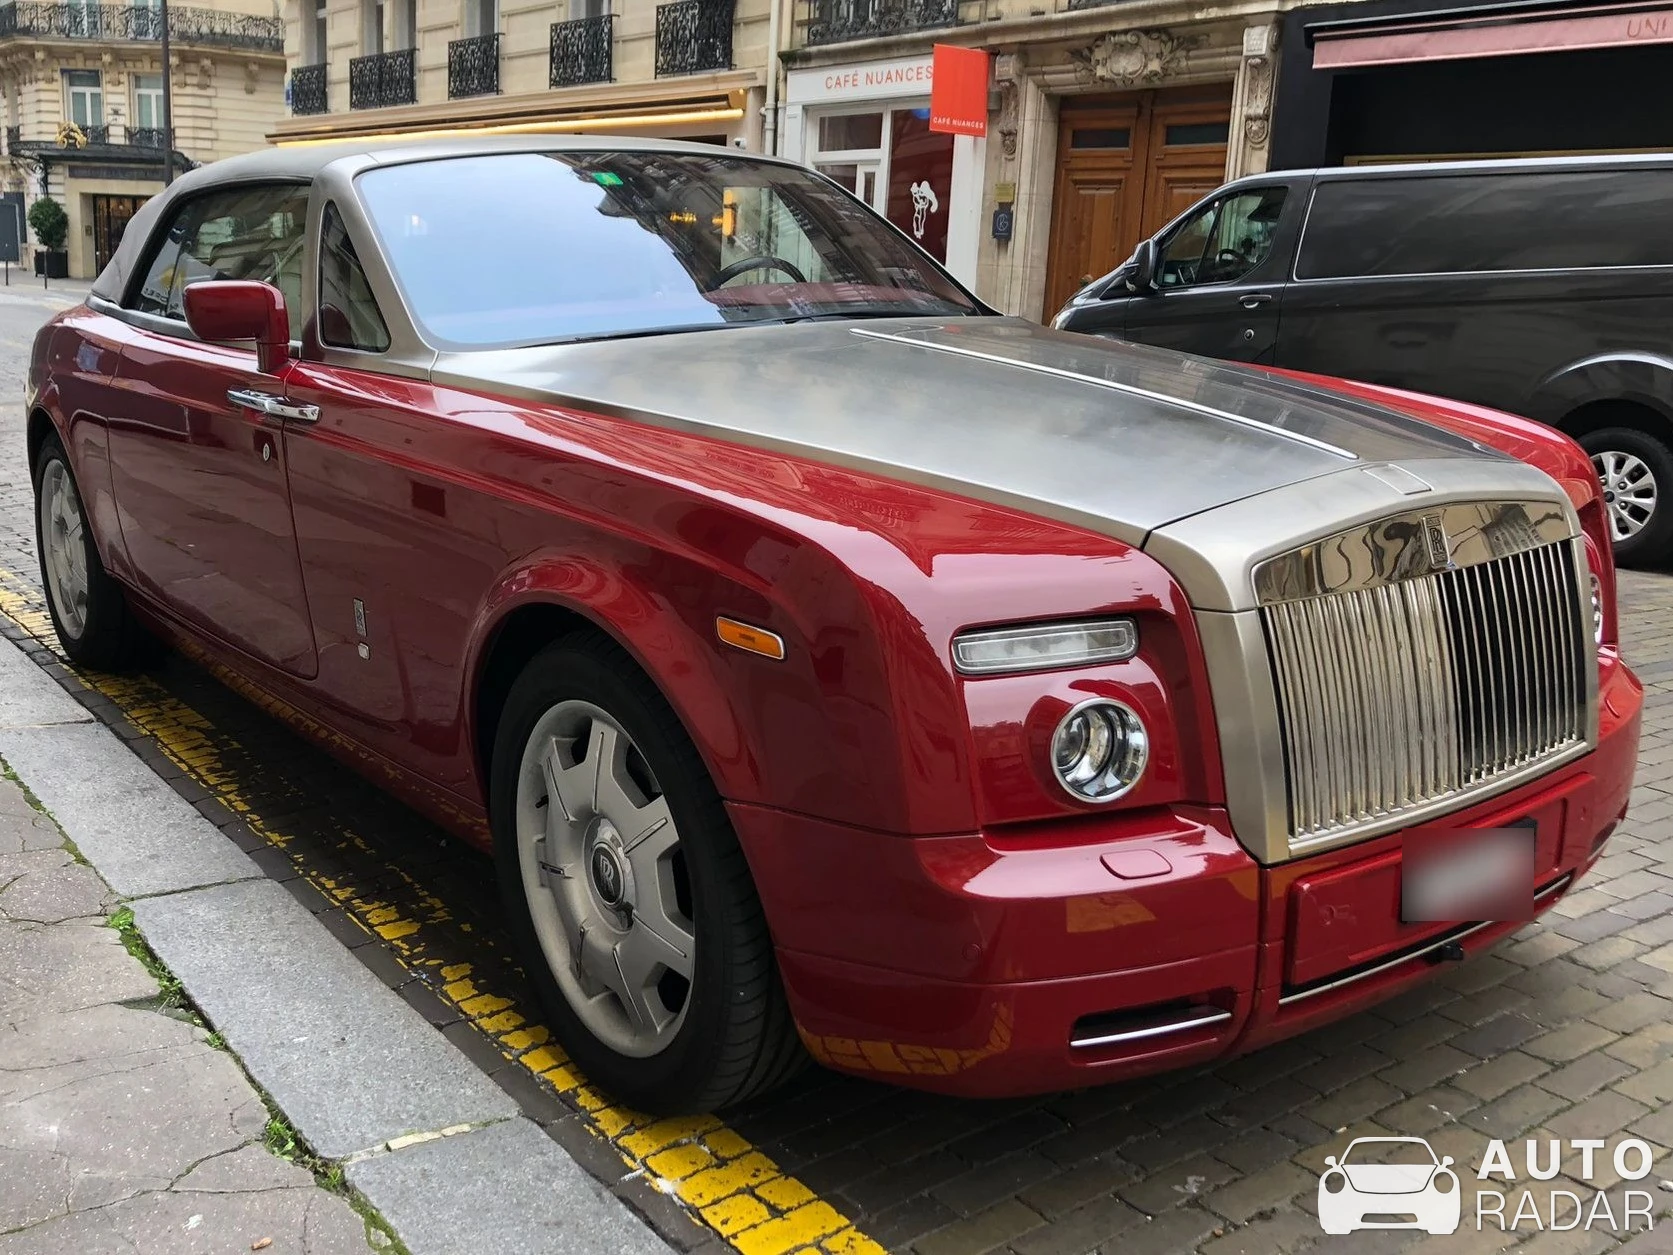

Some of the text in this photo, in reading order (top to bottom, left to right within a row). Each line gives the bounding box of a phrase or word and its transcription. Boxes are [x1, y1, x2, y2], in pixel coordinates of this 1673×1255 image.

[825, 65, 933, 89] CAFÉ NUANCES
[952, 118, 984, 129] NUANCES
